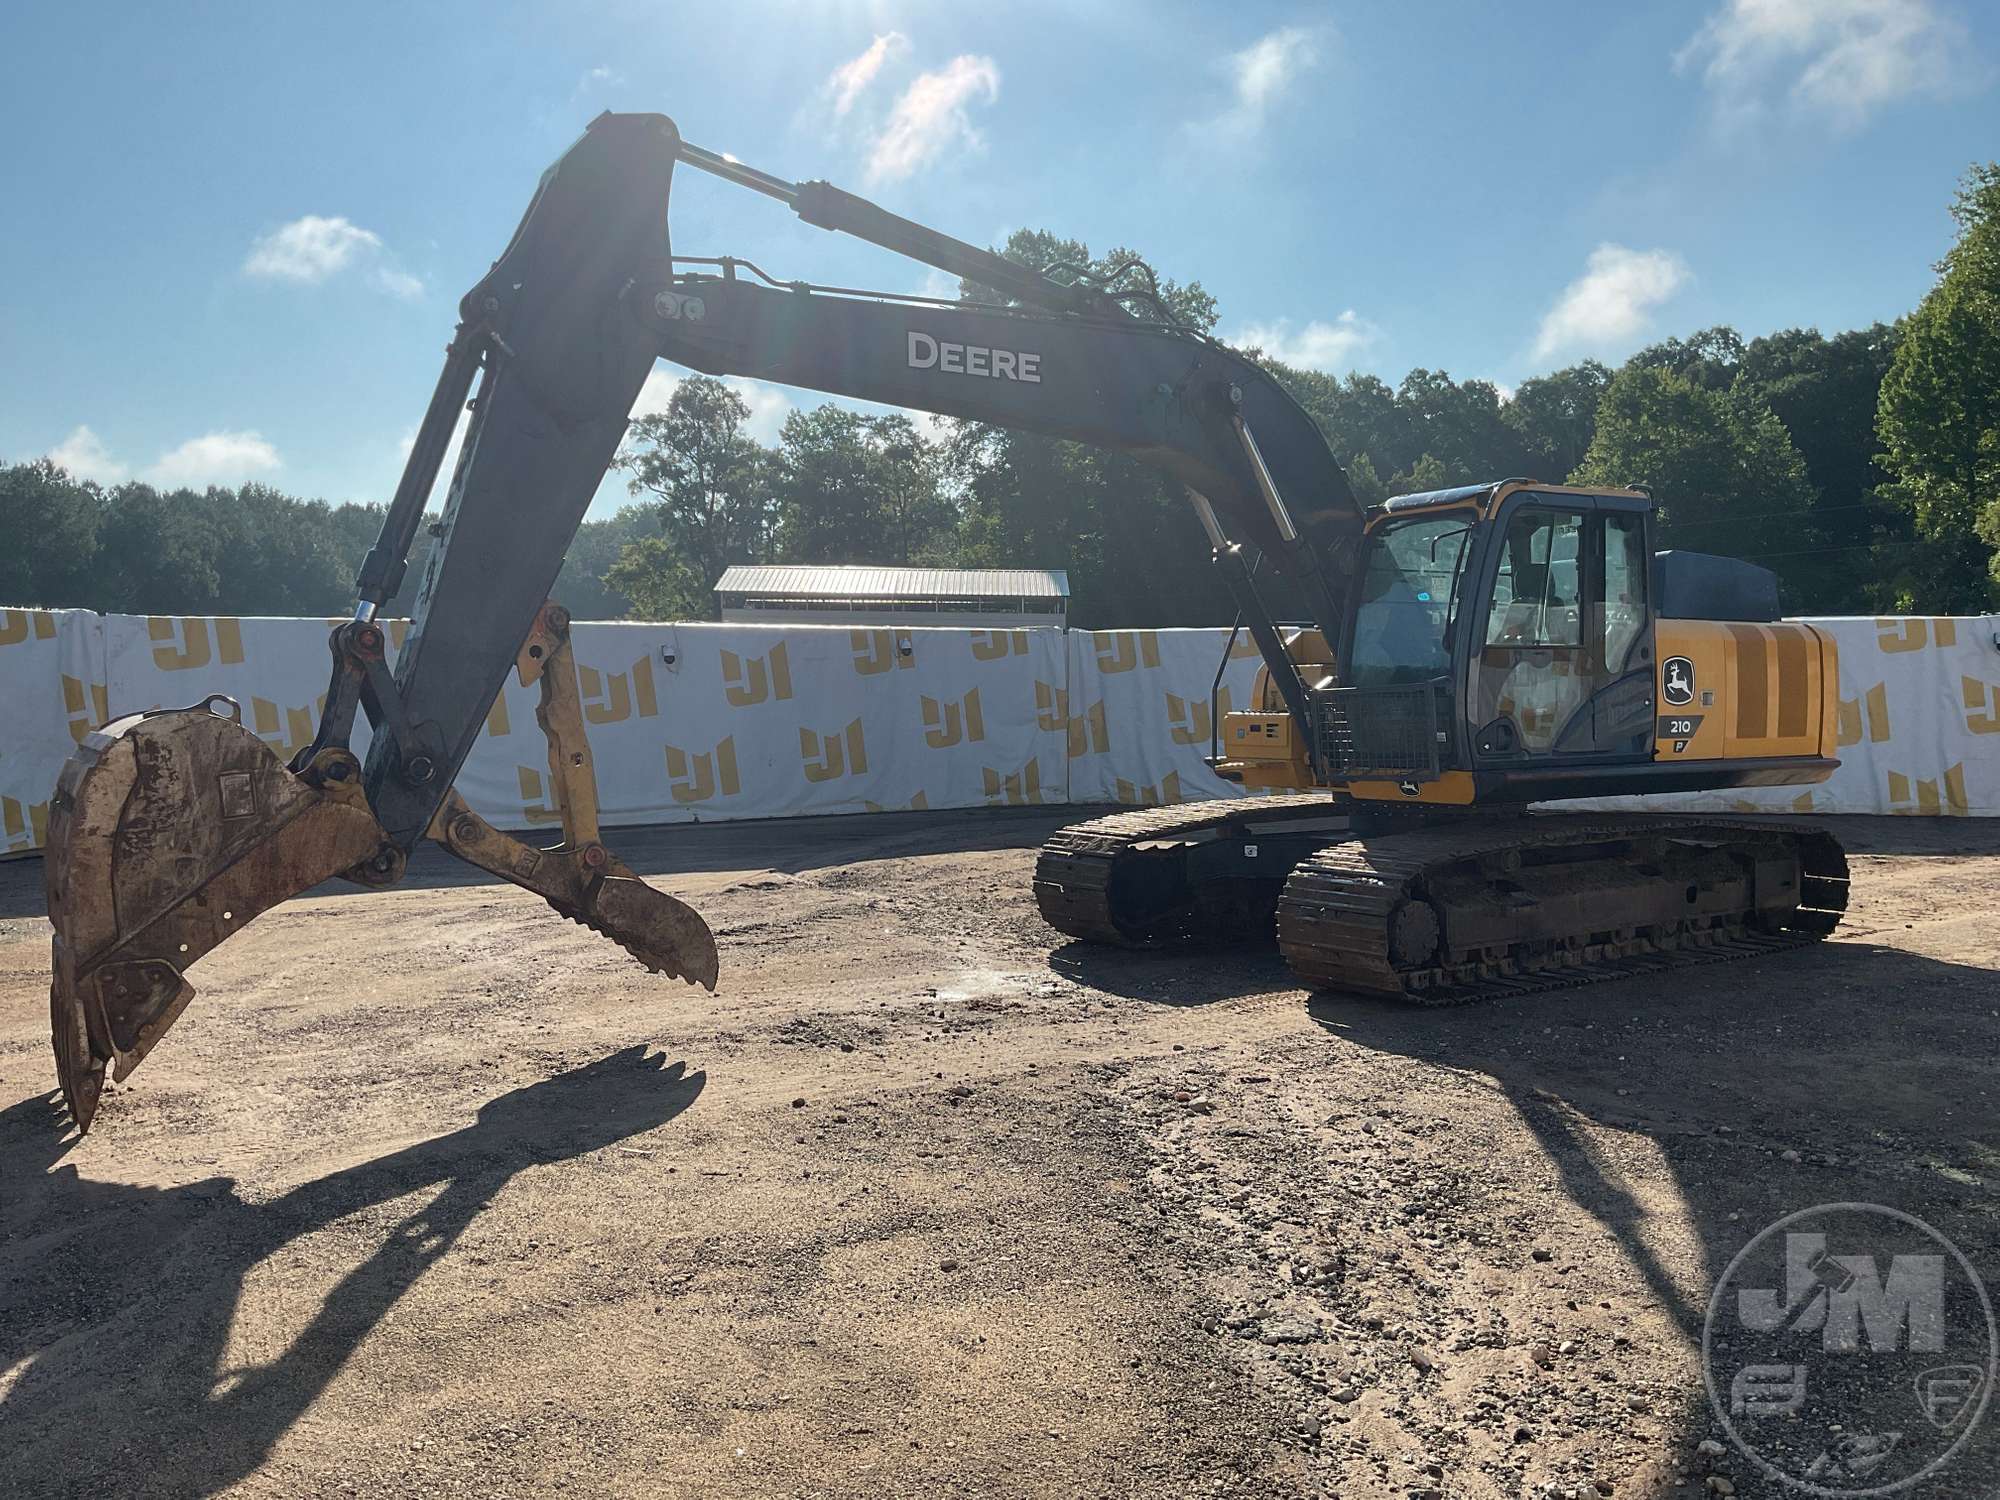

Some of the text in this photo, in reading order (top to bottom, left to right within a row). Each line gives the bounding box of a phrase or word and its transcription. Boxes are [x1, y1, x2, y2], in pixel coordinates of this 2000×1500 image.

[907, 331, 1041, 383] DEERE
[1670, 721, 1691, 733] 210
[1675, 741, 1684, 752] P
